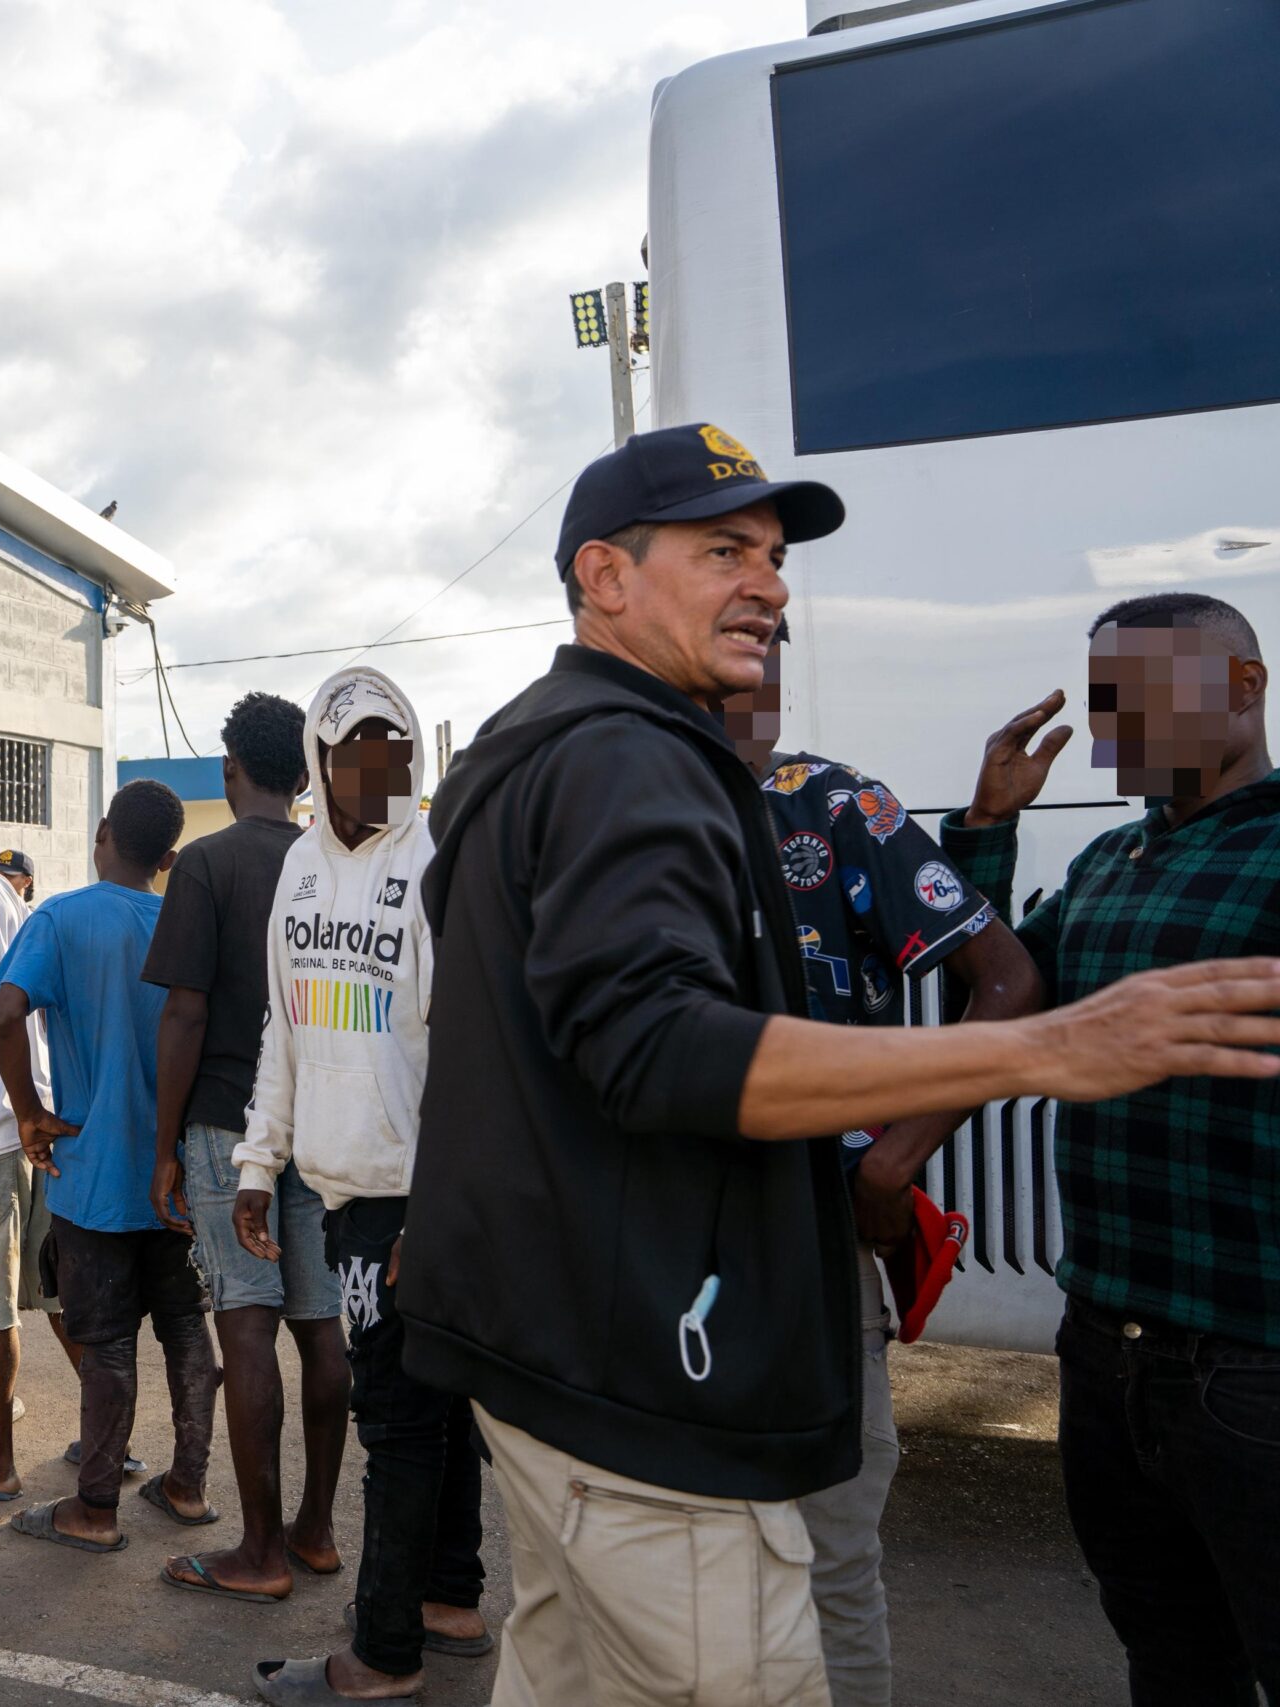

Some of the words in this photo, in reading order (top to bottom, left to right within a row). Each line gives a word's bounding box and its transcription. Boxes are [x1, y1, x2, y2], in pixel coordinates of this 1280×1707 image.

[783, 835, 828, 857] TORONTO
[299, 874, 317, 890] 320
[782, 864, 826, 887] RAPTORS
[919, 880, 959, 902] 76ers
[286, 913, 403, 965] Polaroid
[332, 958, 346, 971] BE
